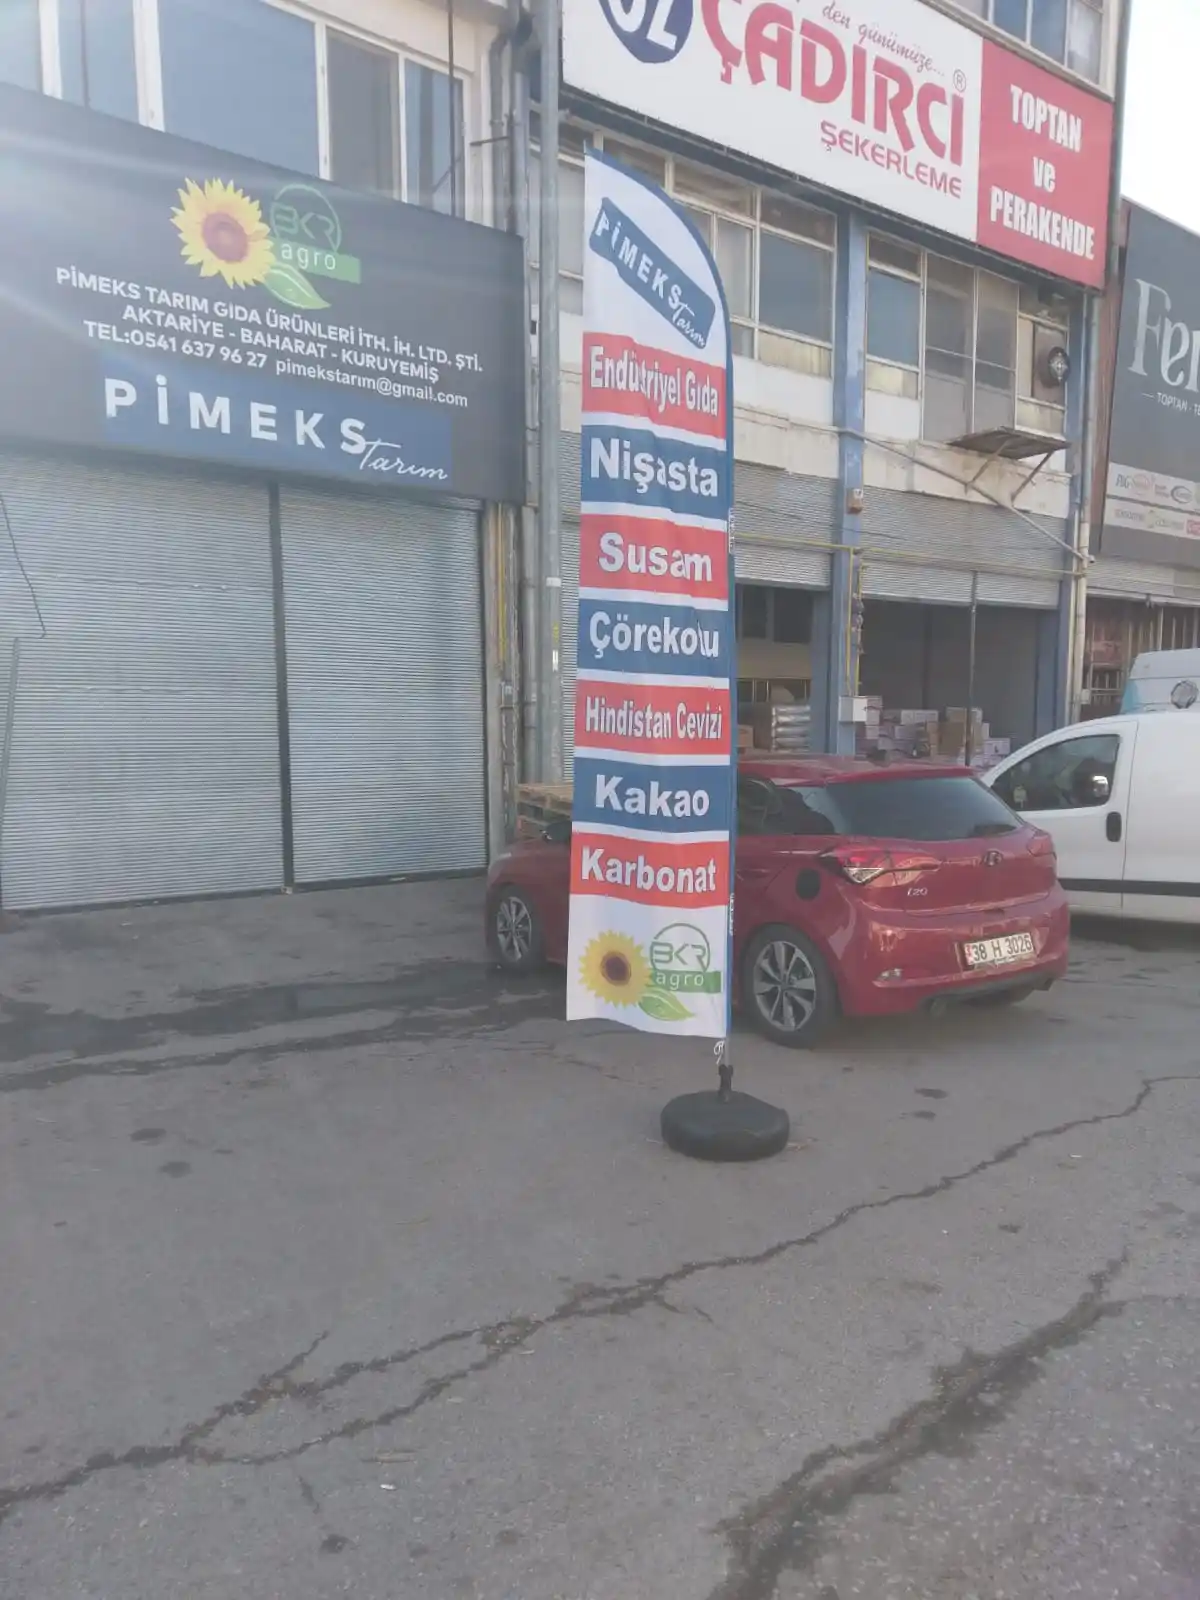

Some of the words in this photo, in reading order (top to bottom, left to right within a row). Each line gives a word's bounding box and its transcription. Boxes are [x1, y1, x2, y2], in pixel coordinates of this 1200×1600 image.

[1010, 84, 1082, 153] TOPTAN
[820, 119, 962, 199] ŞEKERLEME
[1033, 156, 1056, 193] ve
[990, 185, 1094, 261] PERAKENDE
[281, 243, 336, 270] agro
[595, 209, 682, 310] PİMEKS
[56, 266, 141, 299] PİMEKS
[145, 286, 208, 314] TARIM
[213, 301, 261, 325] GIDA
[266, 308, 355, 345] ÜRÜNLERİ
[358, 327, 390, 352] İTH.
[418, 346, 451, 365] LTD.
[456, 353, 483, 372] ŞTİ.
[83, 320, 177, 352] TEL:0541
[181, 339, 215, 359] 637
[219, 348, 243, 364] 96
[246, 353, 267, 369] 27
[122, 305, 224, 338] AKTARİYE
[241, 328, 327, 358] BAHARAT
[341, 349, 439, 383] KURUYEMİŞ
[105, 374, 366, 454] PİMEKS
[685, 369, 718, 417] Gıda
[590, 437, 719, 498] Nişasta
[598, 531, 713, 583] Susam
[585, 696, 672, 739] Hindistan
[676, 703, 722, 741] Cevizi
[594, 773, 709, 817] Kakao
[580, 845, 717, 894] Karbonat
[650, 941, 707, 972] BKR
[972, 943, 988, 961] 38
[991, 939, 1002, 958] H
[655, 972, 704, 990] agro
